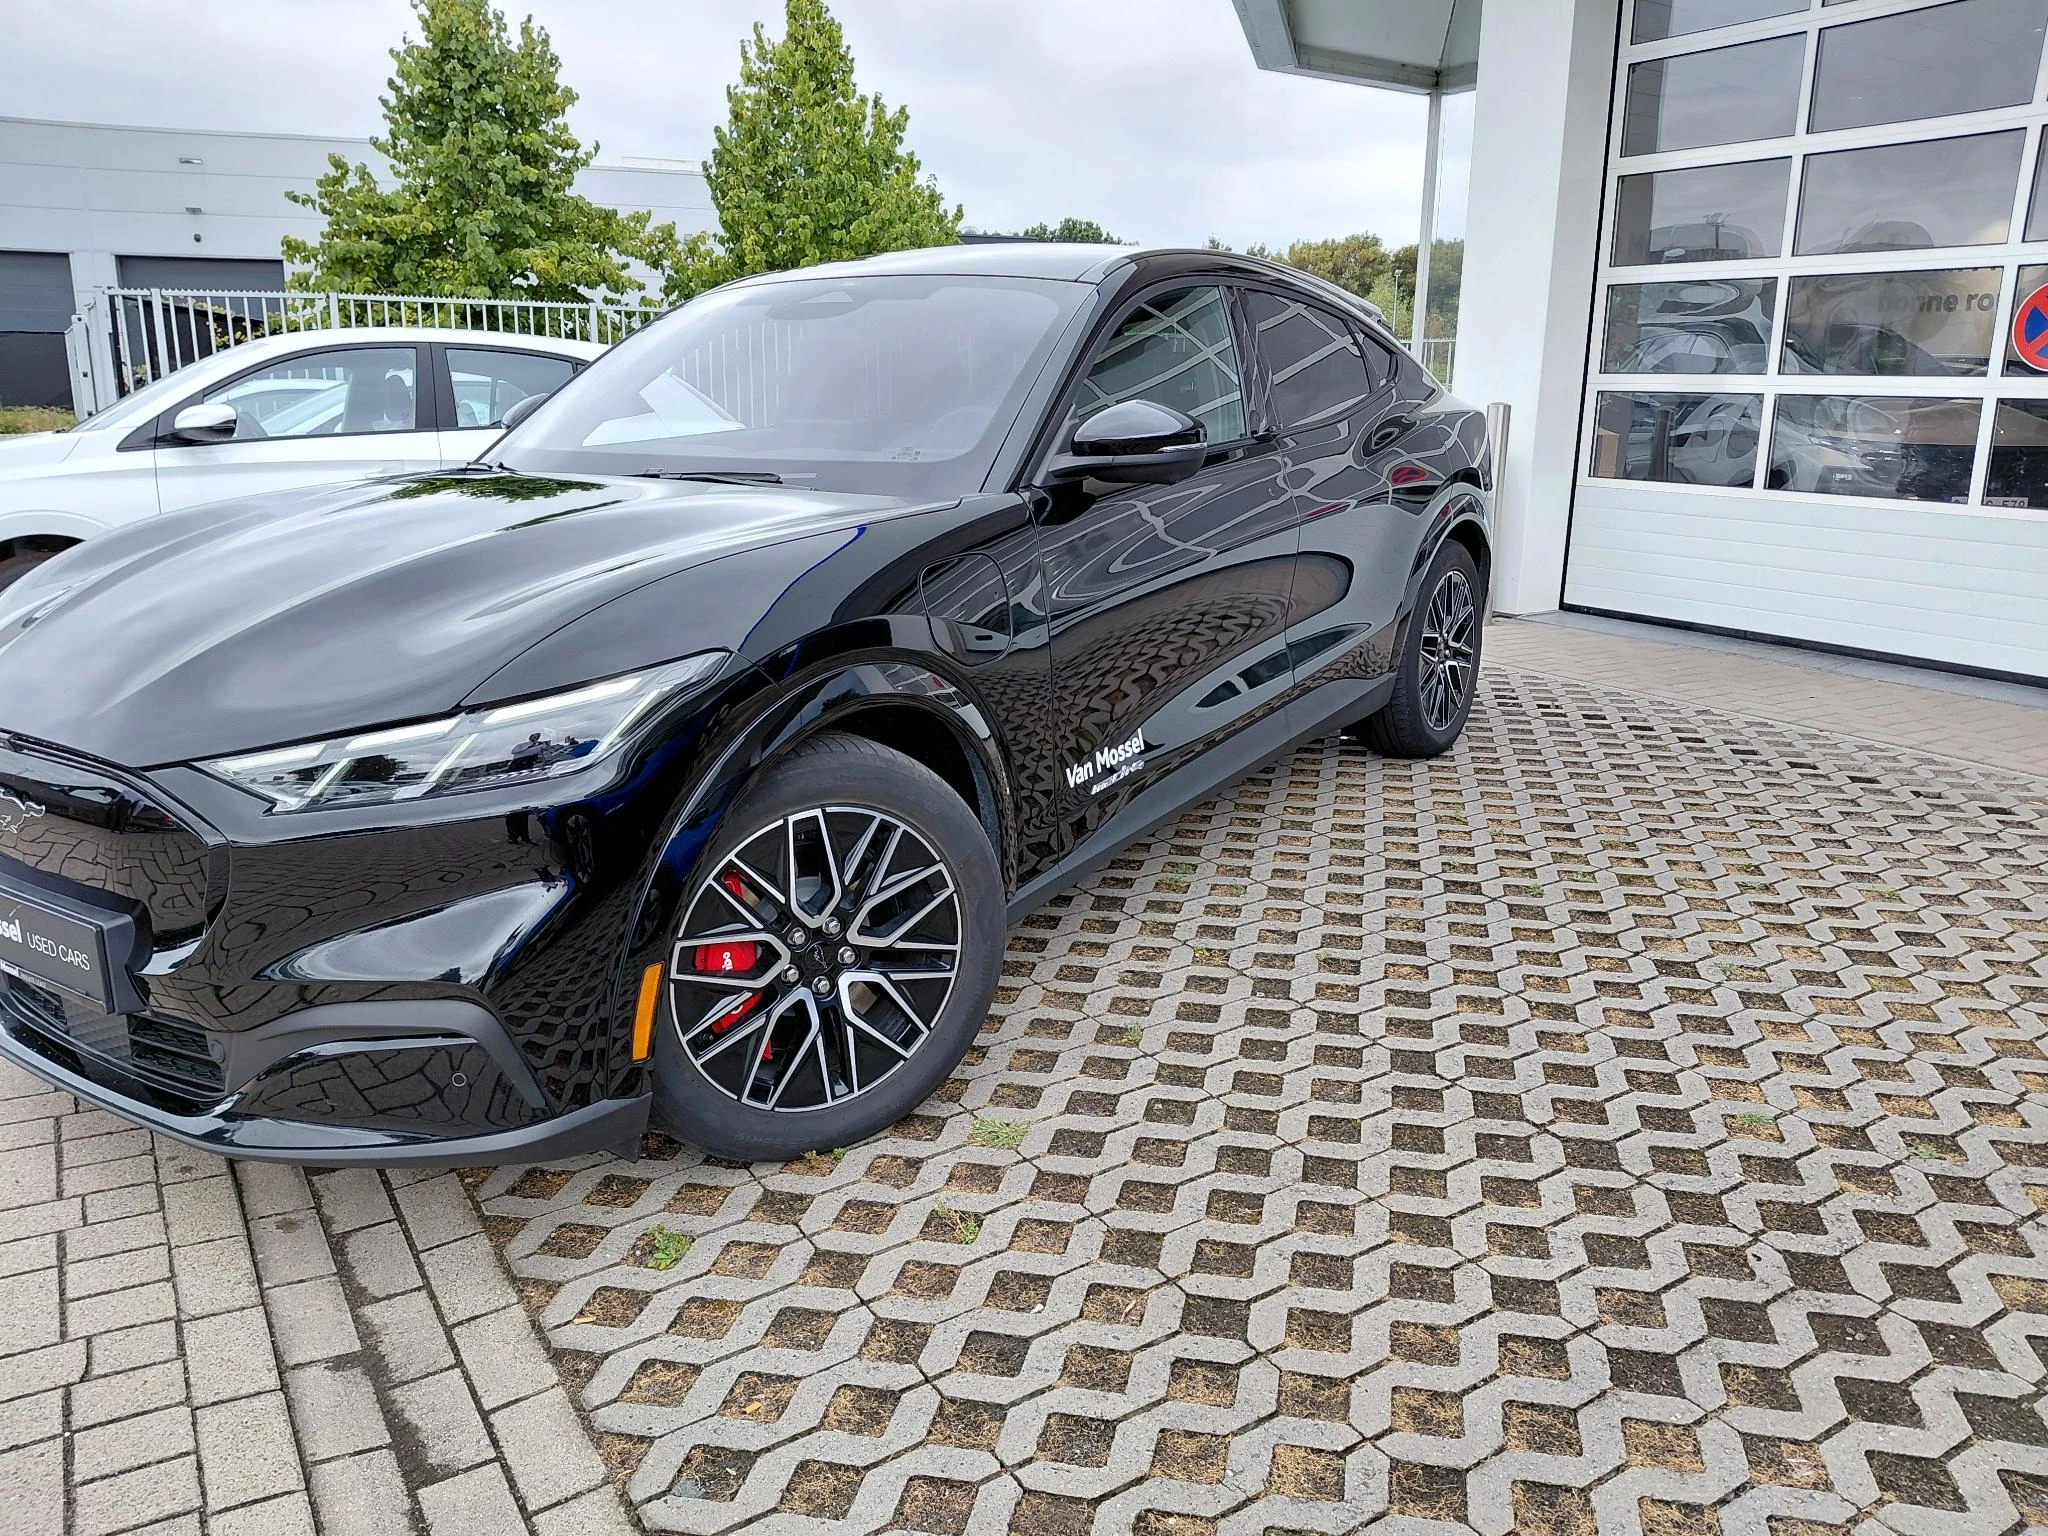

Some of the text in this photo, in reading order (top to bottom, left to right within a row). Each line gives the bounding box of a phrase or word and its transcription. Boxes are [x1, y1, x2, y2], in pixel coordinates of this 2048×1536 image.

[1065, 763, 1094, 788] Van
[1095, 727, 1145, 773] Mossel
[27, 932, 57, 957] USED
[58, 944, 91, 971] CARS
